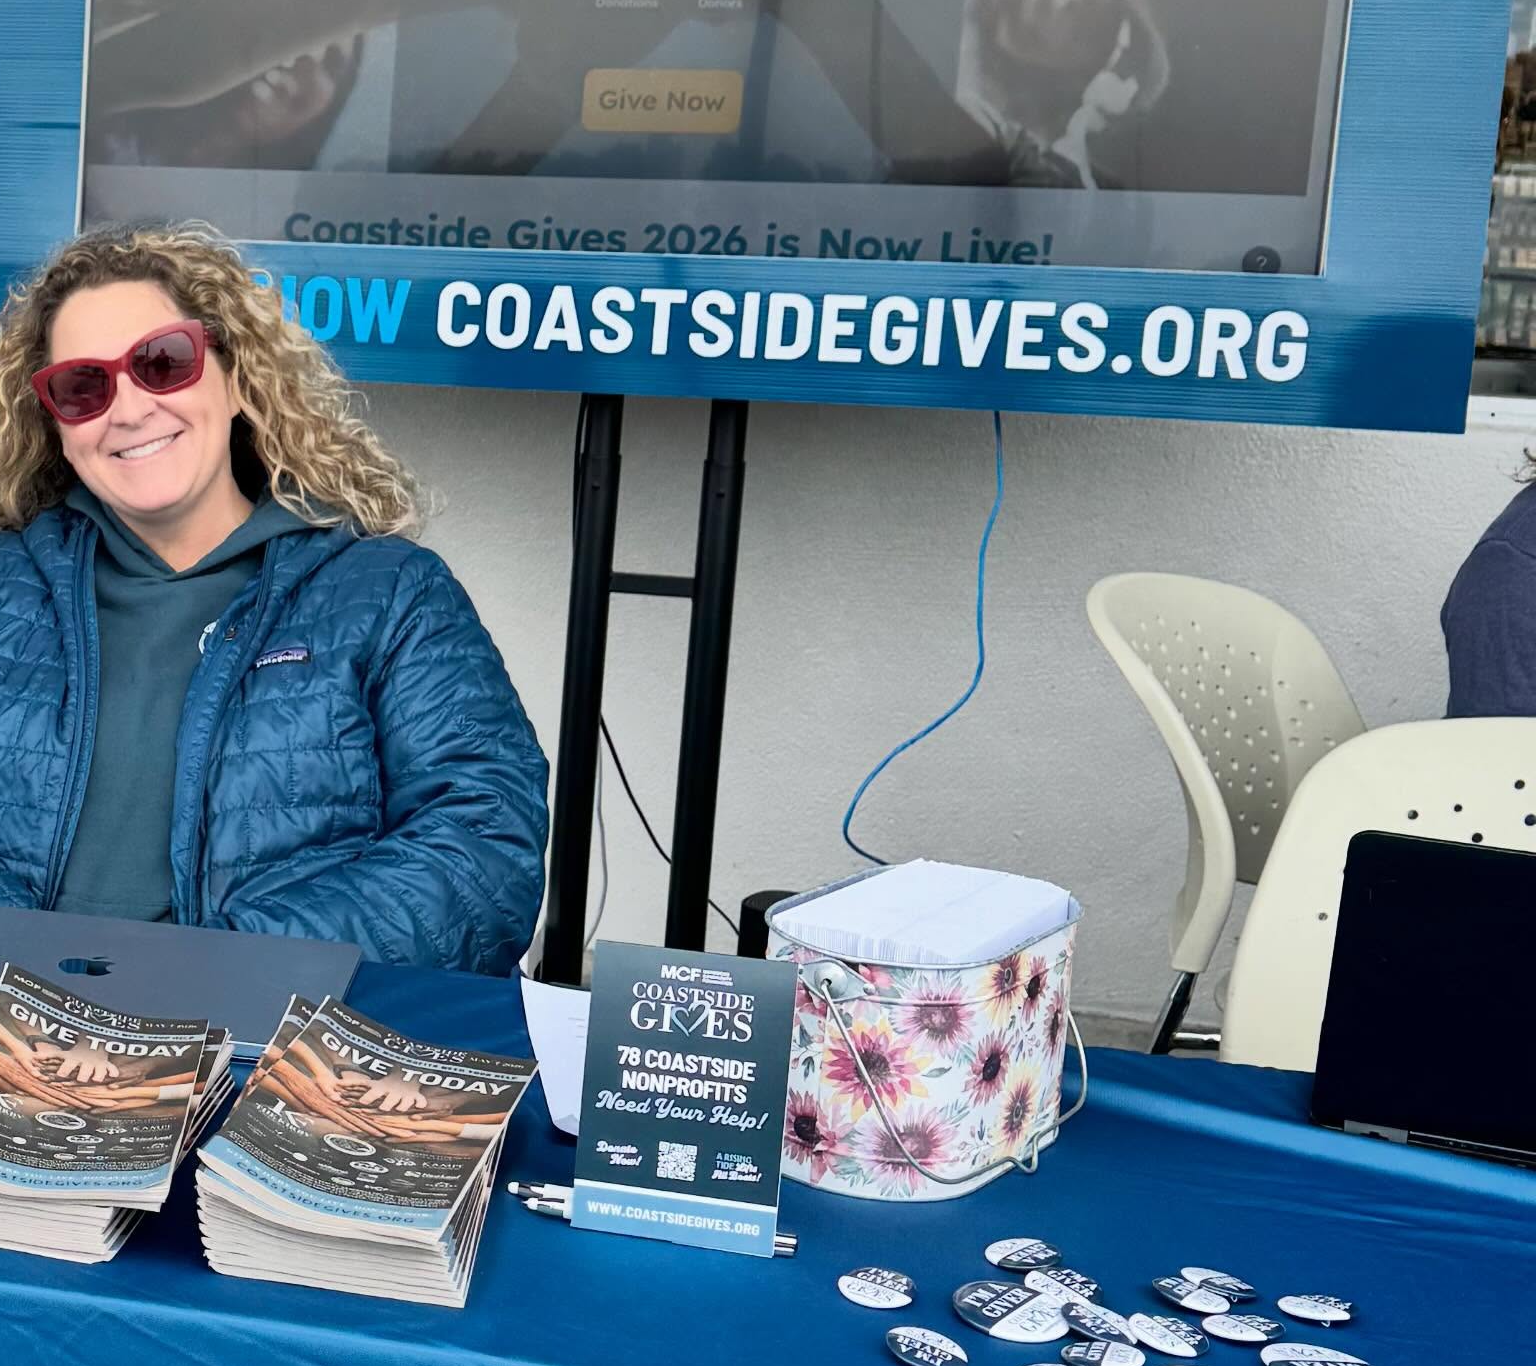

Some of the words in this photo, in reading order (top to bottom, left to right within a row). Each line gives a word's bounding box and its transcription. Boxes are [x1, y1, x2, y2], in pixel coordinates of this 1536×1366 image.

[598, 87, 658, 112] Give
[667, 90, 726, 113] Now
[283, 213, 492, 248] Coastside
[505, 215, 627, 257] Gives
[642, 221, 749, 260] 2026
[765, 221, 801, 261] is
[819, 225, 923, 263] Now
[939, 227, 1056, 267] Live!
[435, 280, 1311, 383] COASTSIDEGIVES.ORG
[660, 964, 703, 983] MCF
[632, 981, 755, 1013] COASTSIDE
[10, 1002, 80, 1044] GIVE
[86, 1035, 193, 1057] TODAY
[321, 1031, 394, 1076] GIVE
[401, 1068, 512, 1096] TODAY
[617, 1045, 642, 1066] 78
[644, 1048, 757, 1083] COASTSIDE
[621, 1069, 748, 1105] NONPROFITS
[595, 1089, 652, 1114] Need
[654, 1098, 707, 1123] Your
[708, 1105, 770, 1132] Help!
[587, 1200, 761, 1237] WWW.COASTSIDEGIVES.ORG
[856, 1271, 909, 1294] GIVER
[963, 1288, 997, 1307] I'M
[988, 1283, 1008, 1293] A
[1046, 1269, 1095, 1298] GIVER
[982, 1288, 1033, 1318] GIVER
[896, 1335, 954, 1361] GIVER
